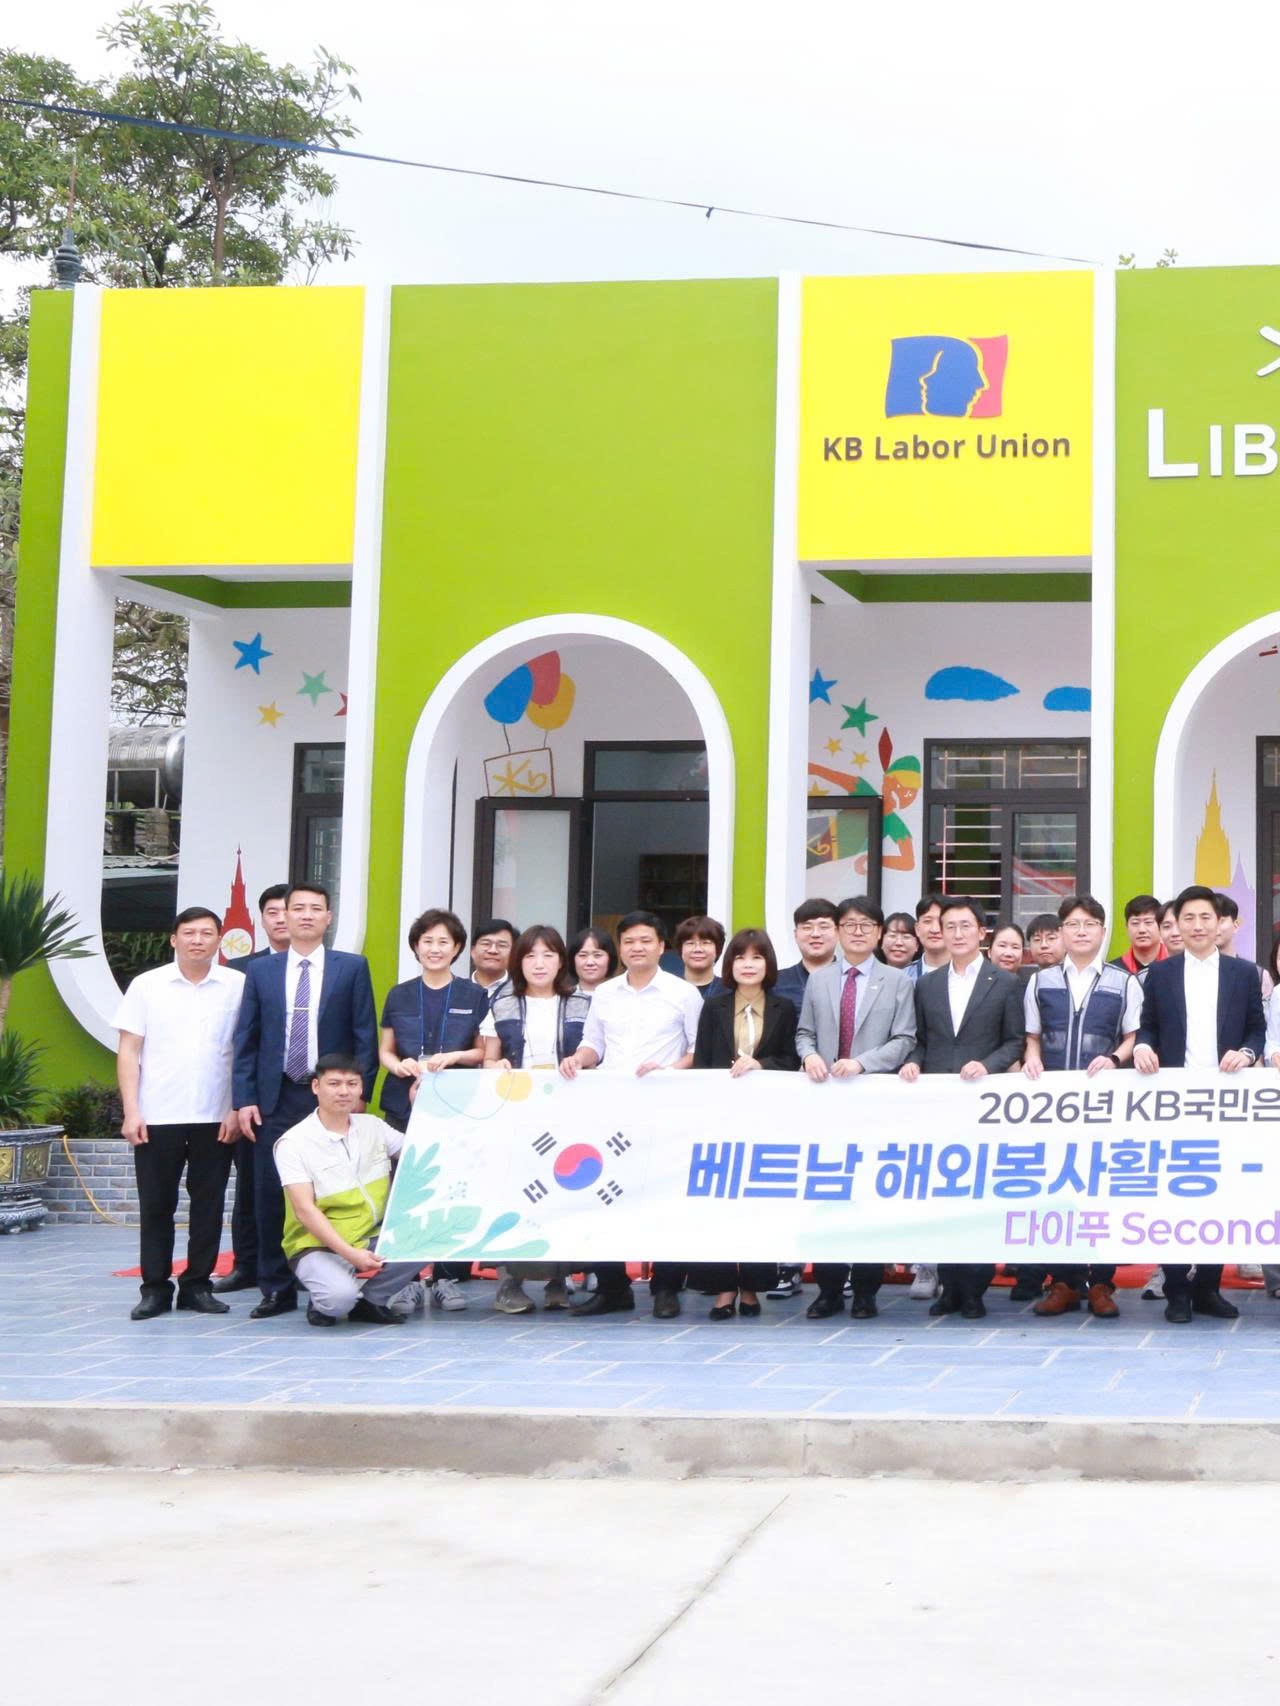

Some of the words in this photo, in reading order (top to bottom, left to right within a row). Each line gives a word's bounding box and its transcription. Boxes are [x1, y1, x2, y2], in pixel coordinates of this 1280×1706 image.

[824, 437, 863, 461] KB
[875, 434, 965, 461] Labor
[977, 432, 1070, 459] Union
[978, 1089, 1114, 1124] 2026년
[686, 1141, 863, 1200] 베트남
[875, 1139, 1221, 1200] 해외봉사활동
[1004, 1210, 1110, 1247] 다이푸
